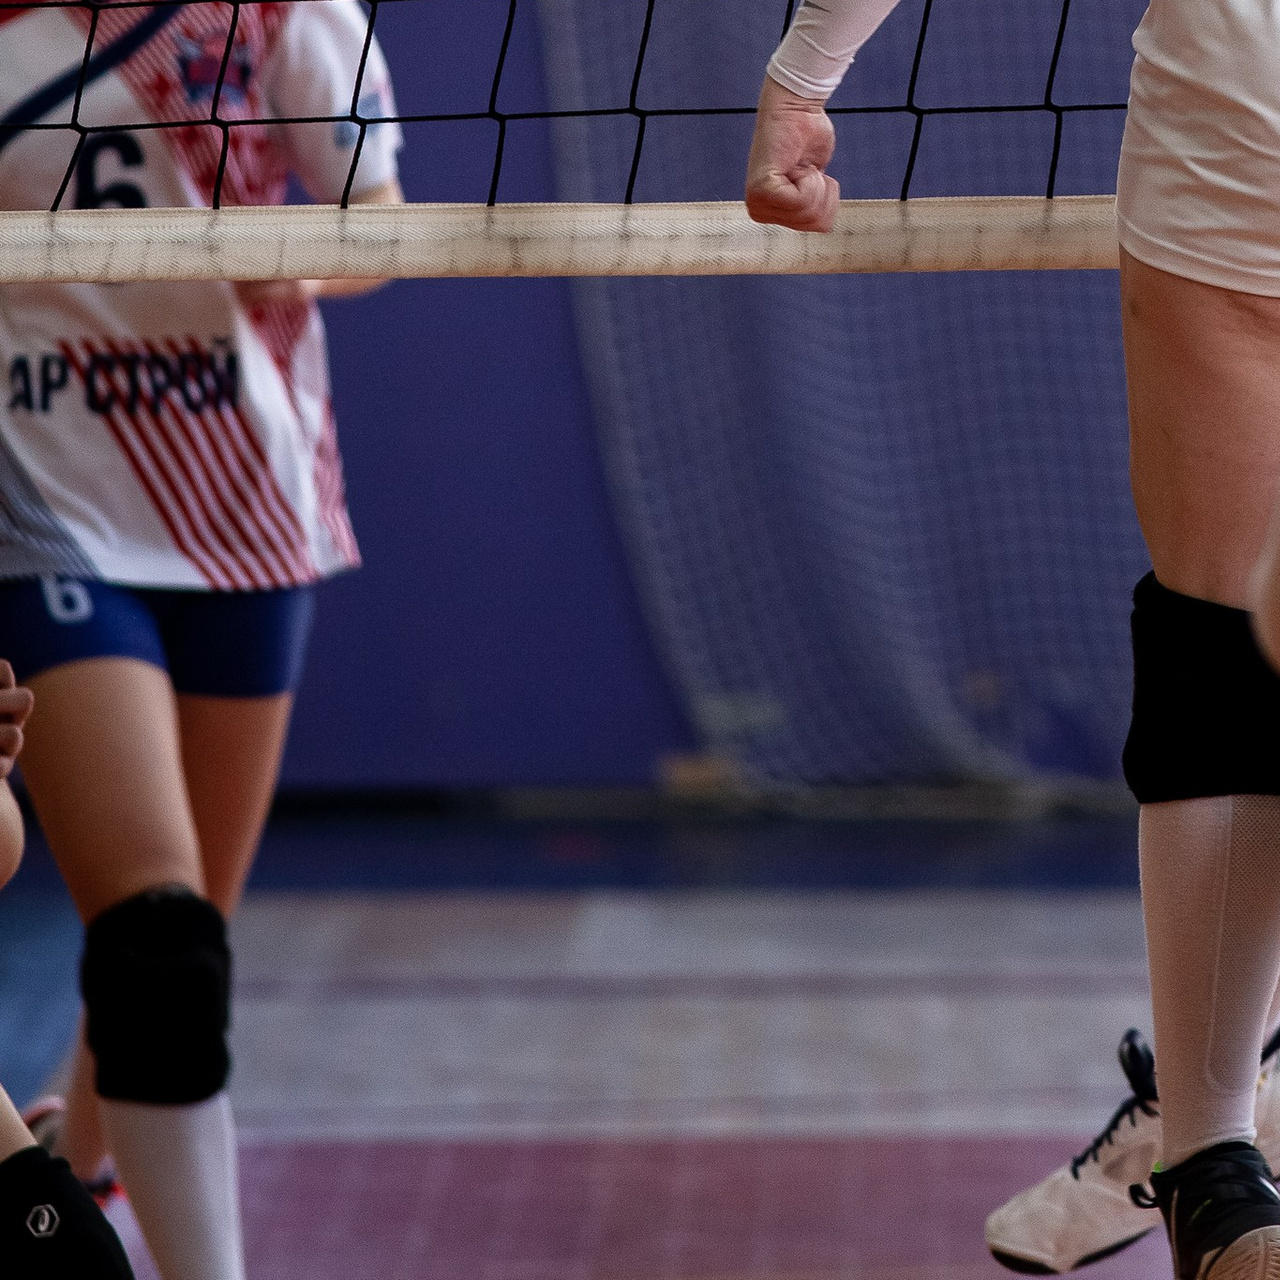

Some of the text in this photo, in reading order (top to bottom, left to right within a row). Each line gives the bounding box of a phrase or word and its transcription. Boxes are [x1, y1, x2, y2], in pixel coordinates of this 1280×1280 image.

[75, 130, 147, 209] 6
[86, 336, 238, 416] СТРОЙ
[41, 574, 95, 624] 6
